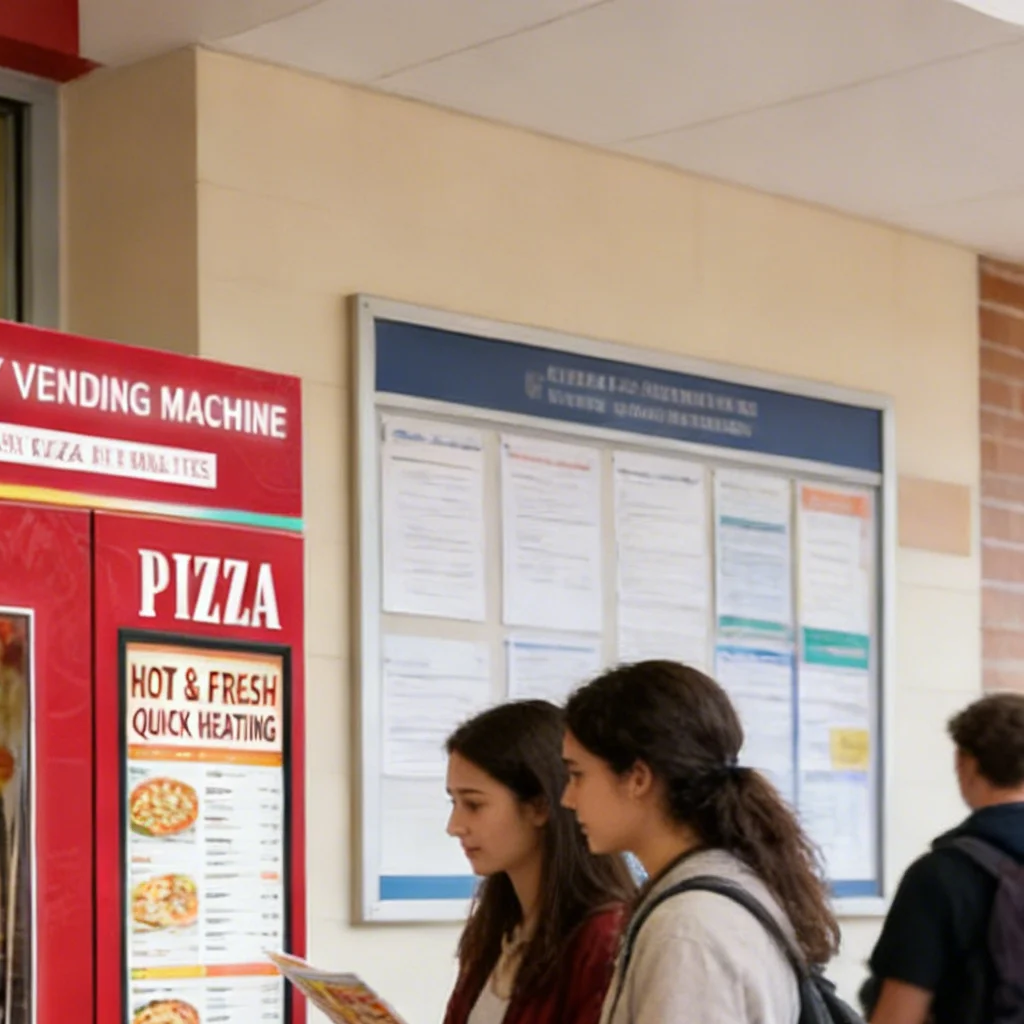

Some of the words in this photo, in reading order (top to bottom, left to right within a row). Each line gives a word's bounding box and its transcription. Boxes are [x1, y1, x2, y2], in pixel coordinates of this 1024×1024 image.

[11, 360, 151, 416] VENDING
[160, 386, 287, 439] MACHINE
[138, 548, 282, 630] PIZZA
[131, 664, 178, 701] HOT
[184, 667, 199, 701] &
[208, 671, 278, 706] FRESH
[133, 708, 193, 740] QUICK
